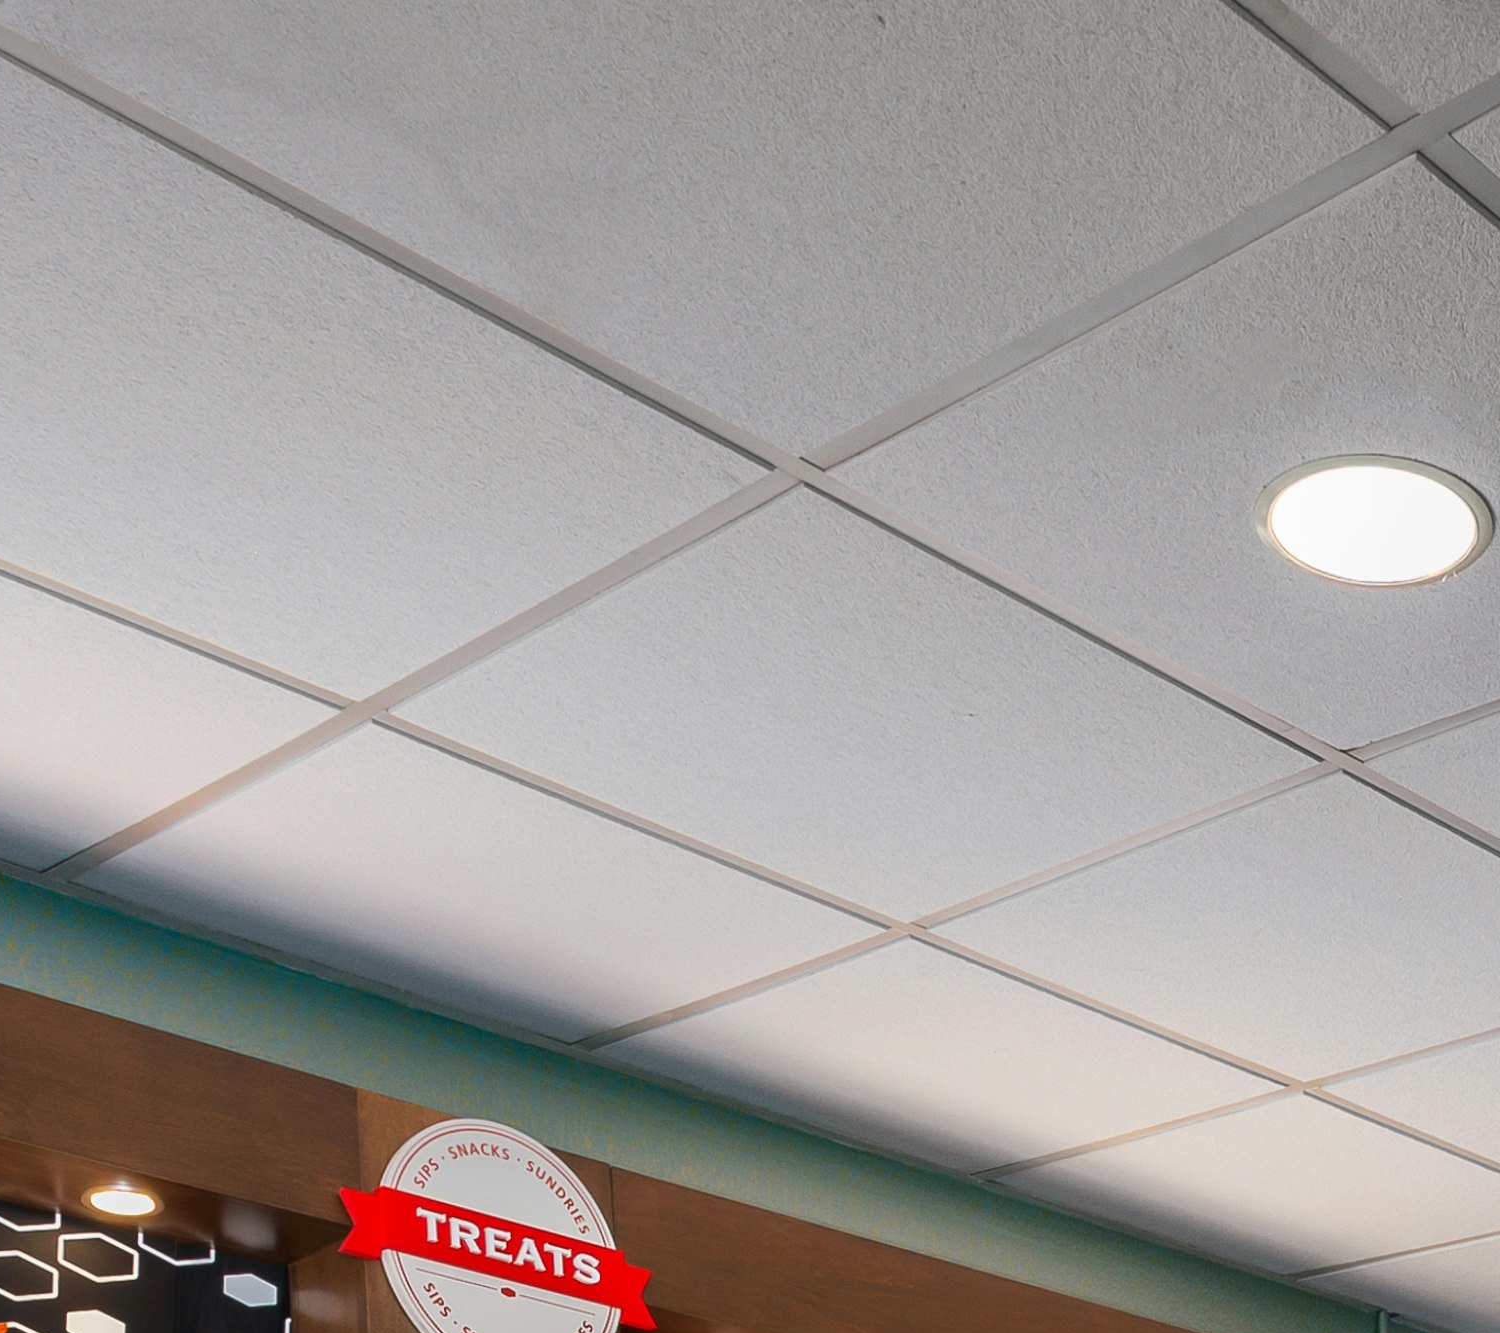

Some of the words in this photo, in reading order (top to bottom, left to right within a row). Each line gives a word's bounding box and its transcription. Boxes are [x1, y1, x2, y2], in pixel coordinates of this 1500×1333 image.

[413, 1156, 440, 1190] SIPS
[447, 1142, 511, 1162] SNACKS
[526, 1160, 591, 1236] SUNDRIES
[416, 1206, 601, 1285] TREATS
[423, 1282, 452, 1318] SIPS
